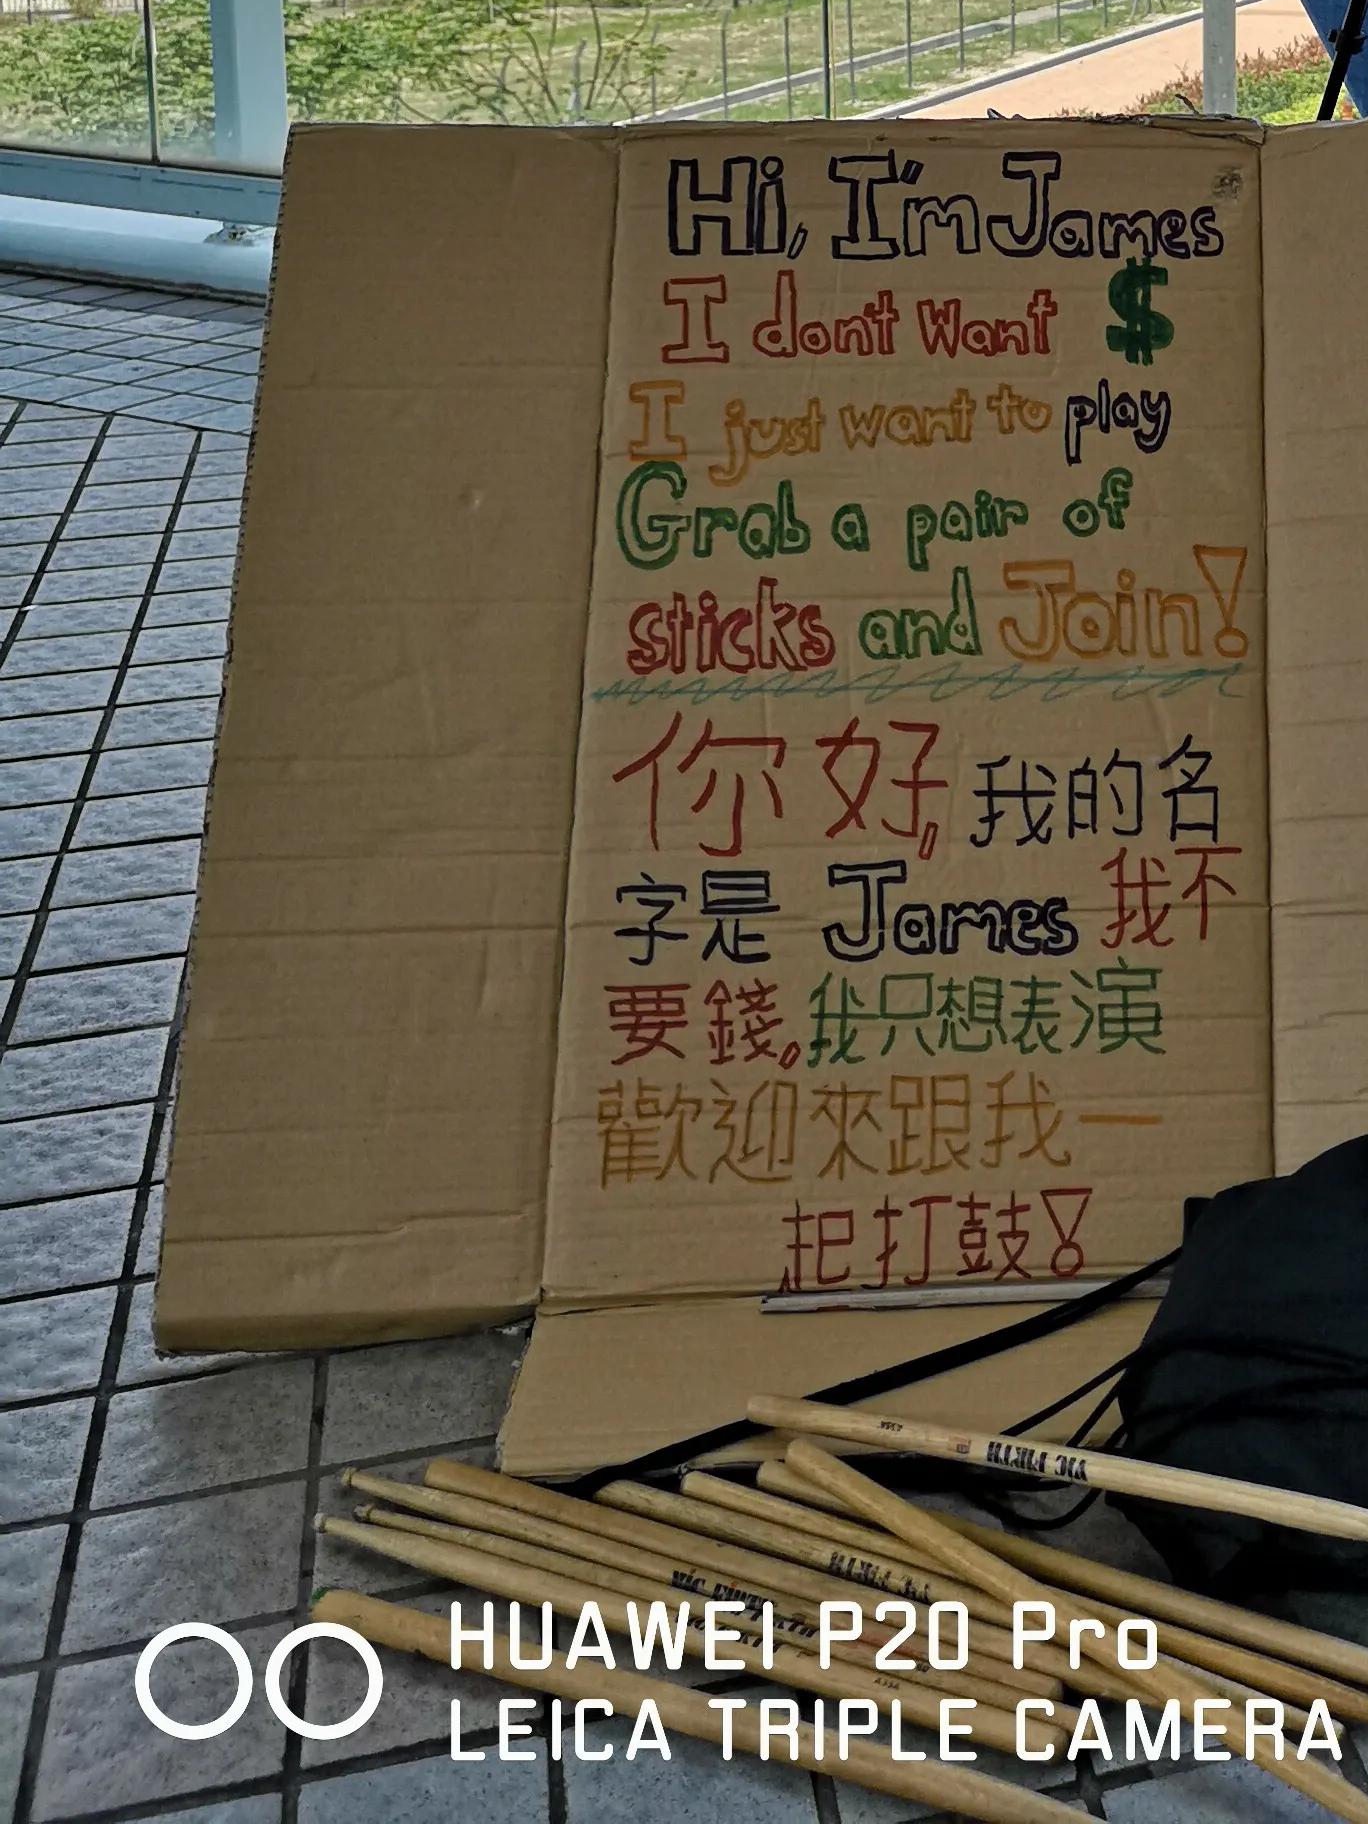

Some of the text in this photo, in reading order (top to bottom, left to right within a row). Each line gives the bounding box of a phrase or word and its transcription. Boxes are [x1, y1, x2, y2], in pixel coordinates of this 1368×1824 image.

[668, 149, 1224, 260] Hi, I'm James
[662, 274, 730, 364] I
[1105, 256, 1174, 367] $
[628, 378, 1171, 488] I just want to play
[616, 460, 1134, 572] Grab a pair of
[627, 544, 1249, 676] sticks and Join!
[615, 847, 1244, 967] 字是 James 我不
[596, 1069, 1163, 1186] 歡迎來跟我一
[987, 1440, 1049, 1473] FIRTH
[1055, 1454, 1088, 1482] VIC
